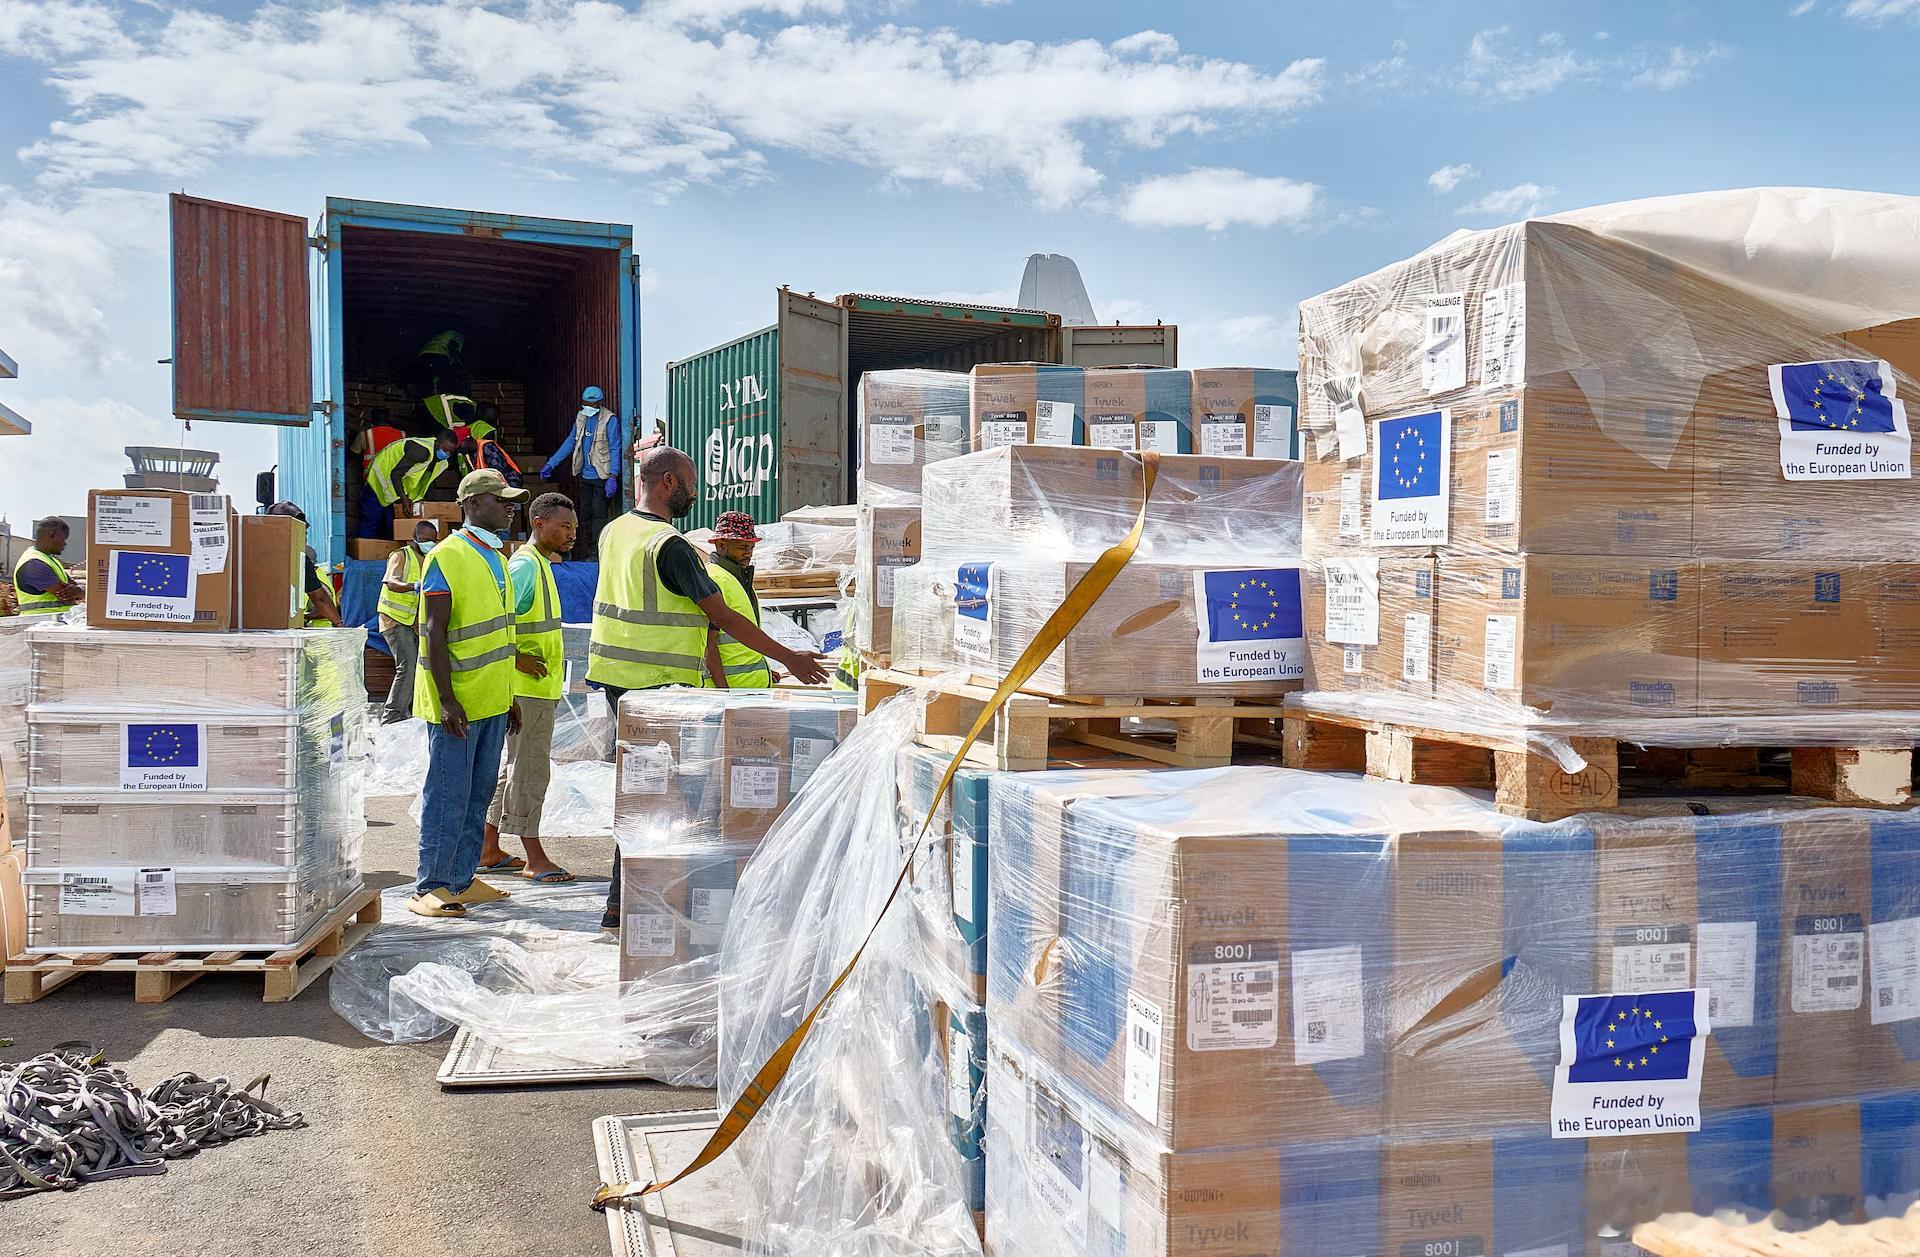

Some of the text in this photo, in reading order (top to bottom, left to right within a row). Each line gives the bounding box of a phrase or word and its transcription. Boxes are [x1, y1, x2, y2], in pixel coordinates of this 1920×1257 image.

[1428, 296, 1460, 307] CHALLENGE
[873, 399, 903, 408] Tyvek
[984, 394, 1016, 405] Tyvek
[1093, 397, 1124, 408] Tyvek
[1203, 397, 1234, 408] Tyvek
[1816, 443, 1880, 457] Funded by
[1786, 461, 1904, 475] the European Union
[1390, 510, 1428, 523] Funded by
[1374, 528, 1444, 542] the European Union
[880, 537, 912, 549] Tyvek
[130, 601, 174, 611] Funded by
[125, 610, 165, 620] European
[167, 612, 191, 620] Union
[1229, 650, 1286, 661] Funded by
[1202, 664, 1304, 678] the European Unio
[735, 736, 767, 748] Tyvek
[143, 773, 186, 783] Funded by
[1559, 772, 1603, 795] EPAL
[123, 782, 203, 791] the European Union
[1814, 918, 1837, 930] 800
[1636, 928, 1661, 941] 800
[1214, 945, 1244, 959] 800
[1826, 943, 1837, 952] LG
[1650, 954, 1661, 963] LG
[1231, 972, 1244, 982] LG
[1130, 998, 1159, 1025] CHALLENGE
[1592, 1094, 1664, 1110] Funded by
[1558, 1114, 1694, 1132] the European Union
[1185, 1221, 1249, 1244] Tyvek
[1425, 1242, 1452, 1257] 800
